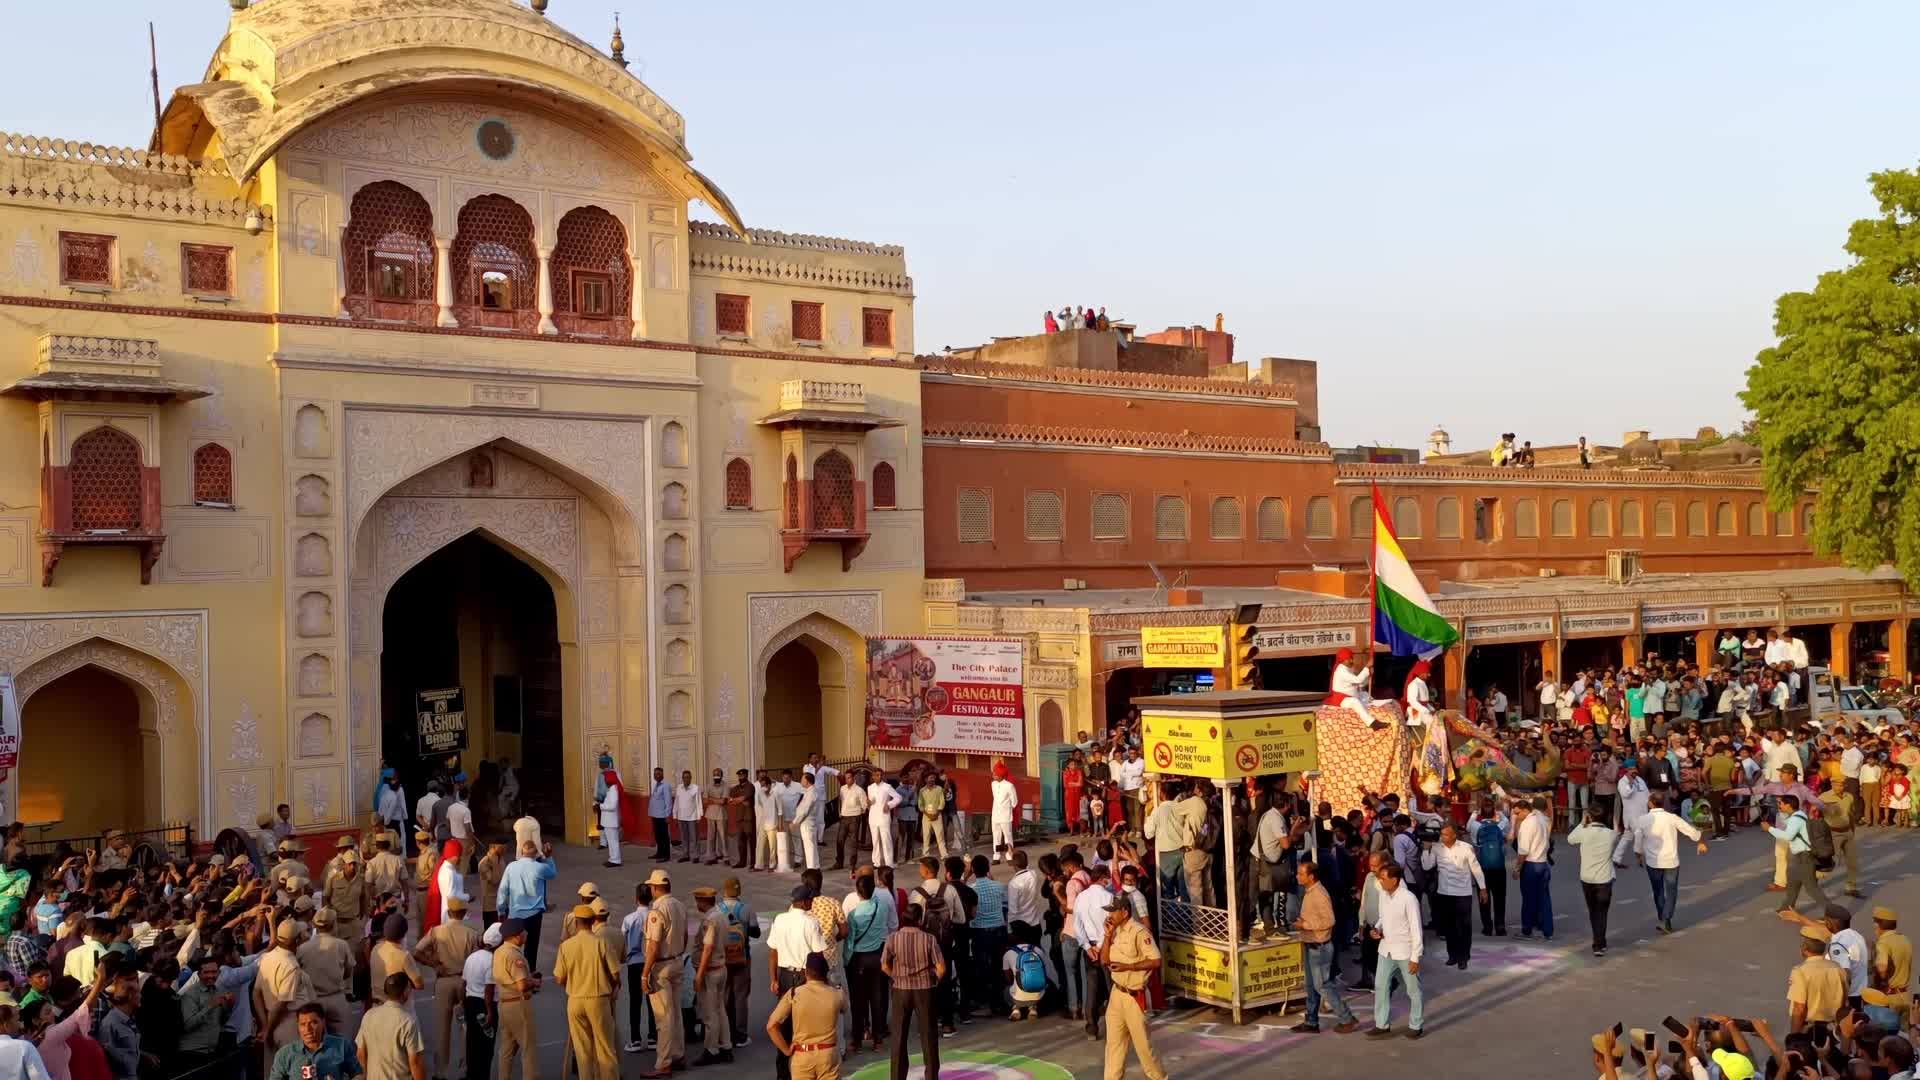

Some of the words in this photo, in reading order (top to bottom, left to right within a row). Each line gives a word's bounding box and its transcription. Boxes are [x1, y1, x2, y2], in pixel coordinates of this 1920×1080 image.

[1147, 644, 1183, 654] GANGAUR
[1184, 644, 1217, 654] FESTIVAL
[969, 664, 985, 672] City
[989, 665, 1018, 673] Palace
[952, 687, 1015, 701] GANGAUR
[952, 705, 990, 714] FESTIVAL
[992, 707, 1015, 716] 2022
[421, 713, 464, 733] ASHOK
[426, 732, 453, 745] BAND
[1262, 744, 1272, 752] DO
[1274, 742, 1289, 750] NOT
[1263, 751, 1283, 760] HONK
[1285, 749, 1304, 758] YOUR
[1176, 762, 1192, 770] HORN
[1263, 760, 1284, 768] HORN
